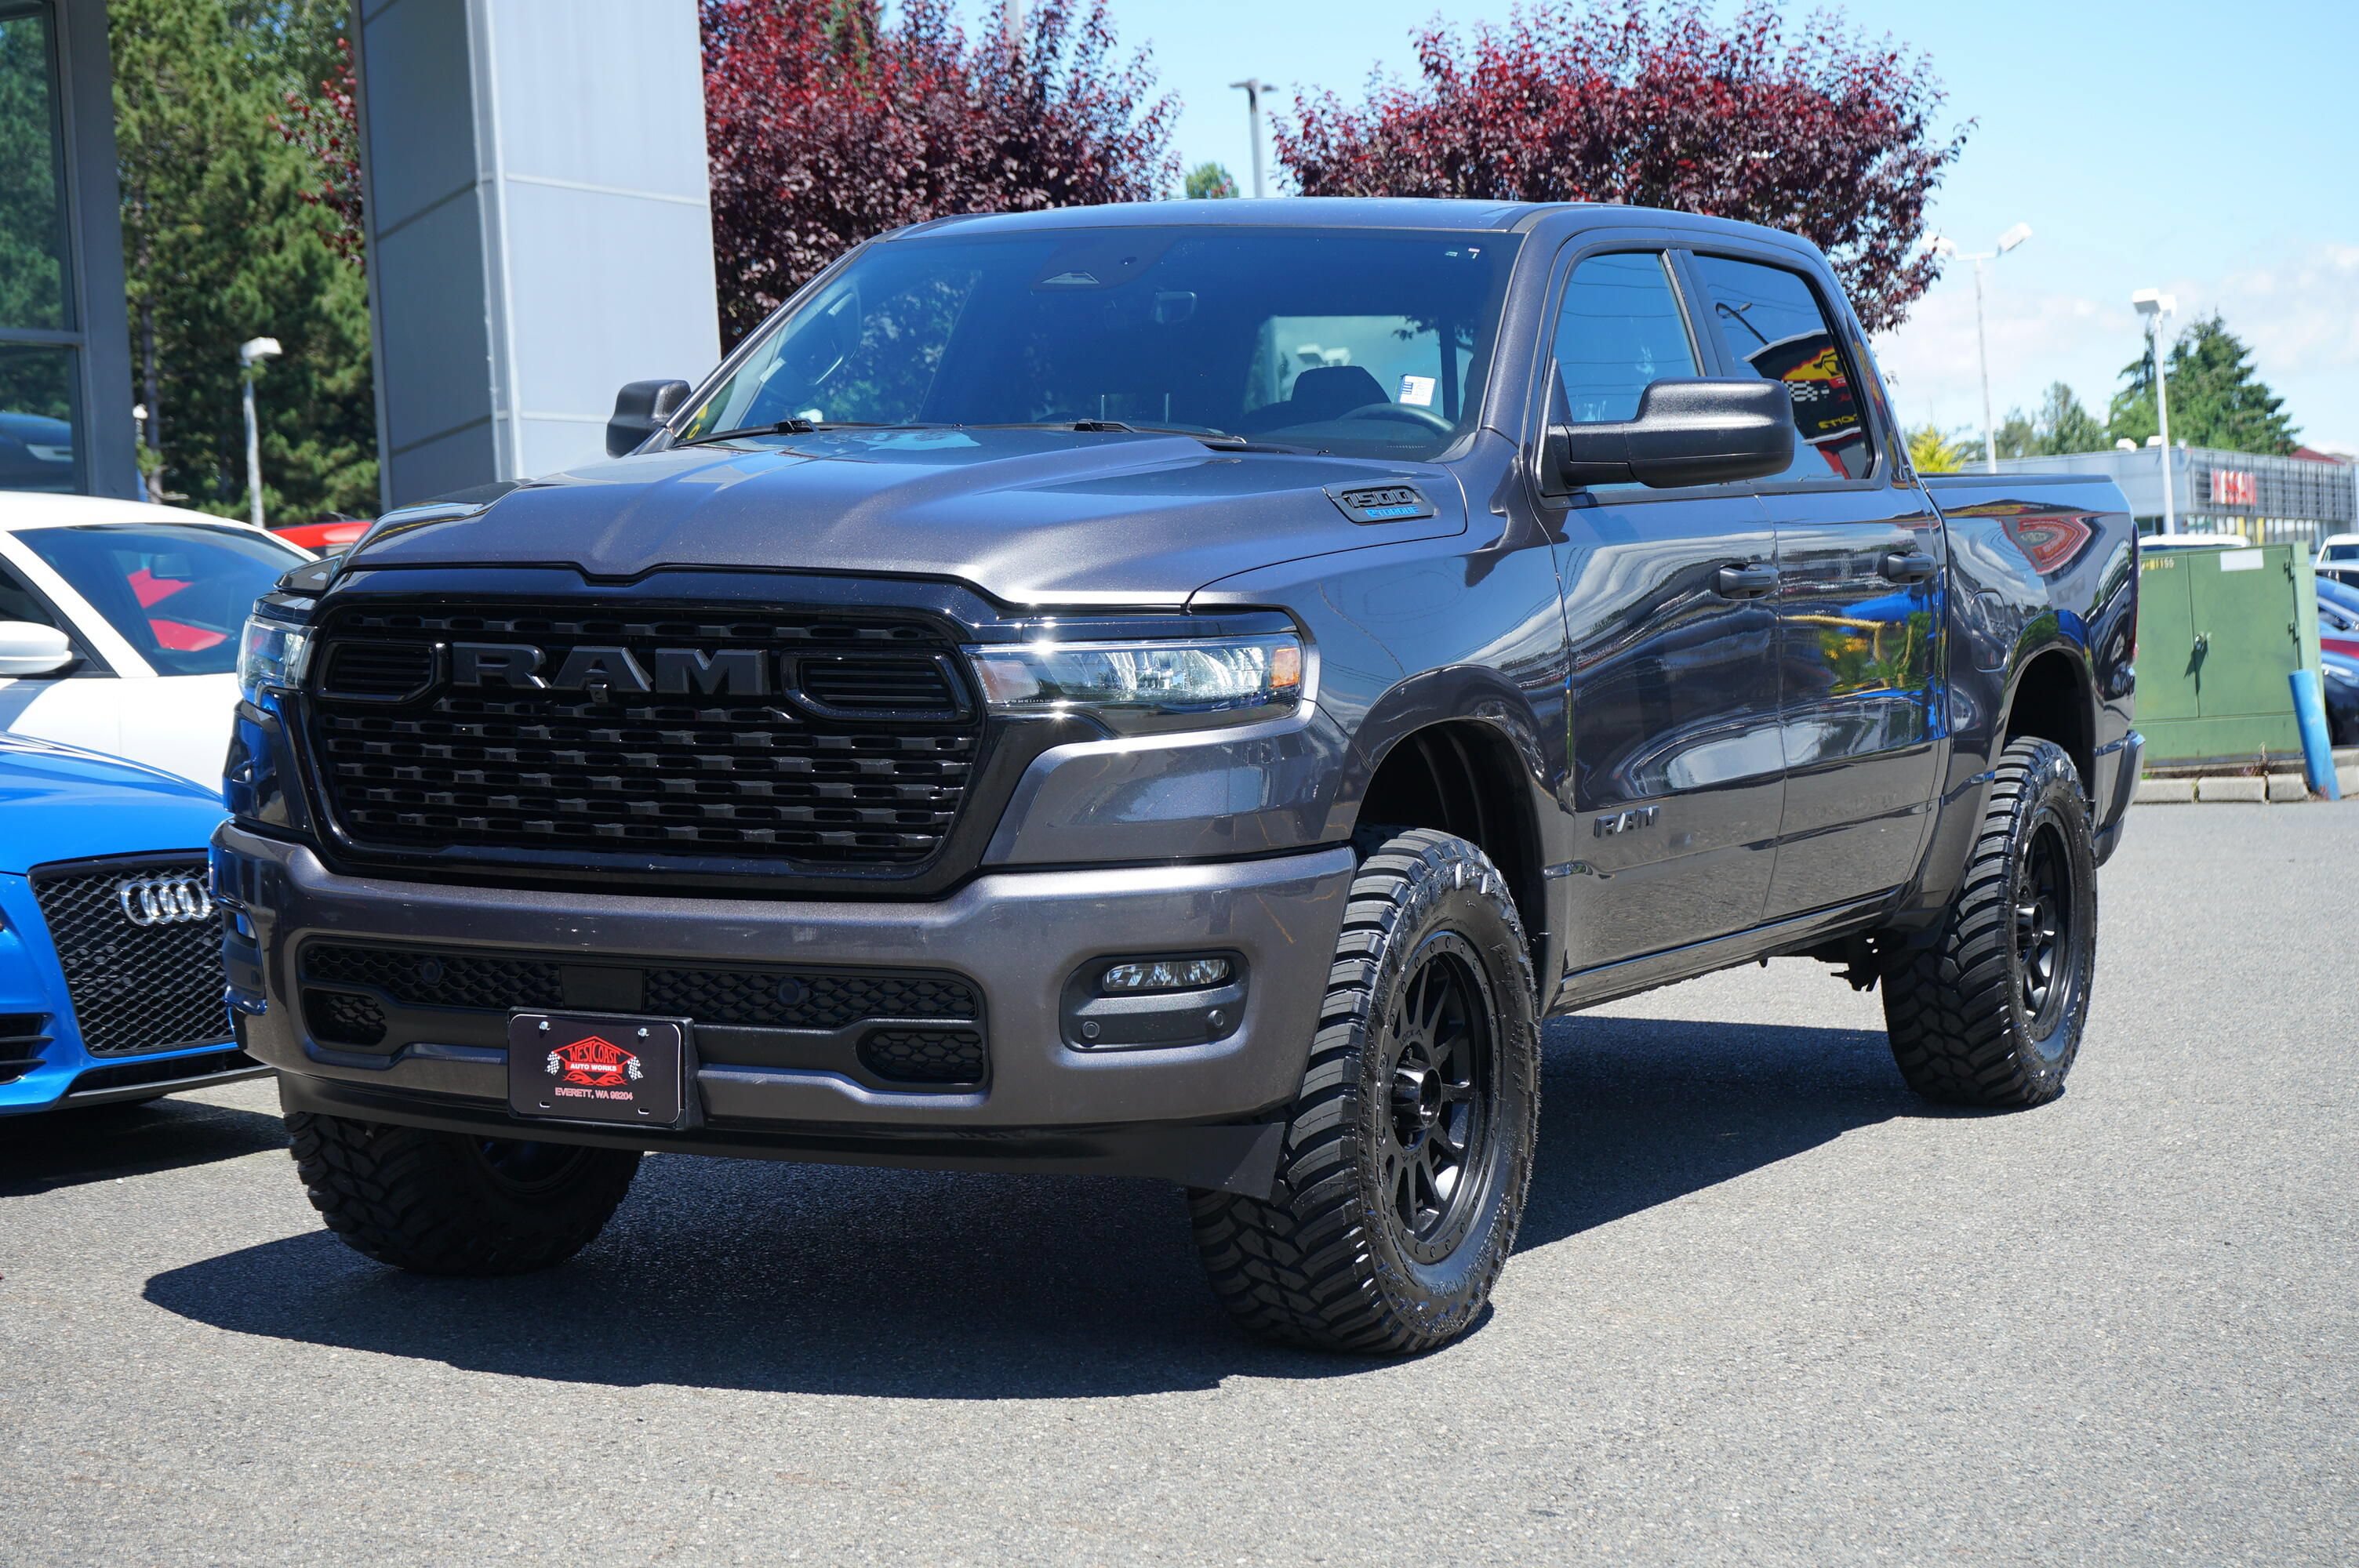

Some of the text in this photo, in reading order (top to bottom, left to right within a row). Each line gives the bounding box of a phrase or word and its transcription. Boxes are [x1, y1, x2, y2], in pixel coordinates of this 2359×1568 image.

[1343, 488, 1412, 508] 1500
[452, 641, 772, 695] RAM
[1593, 805, 1659, 837] RAM
[554, 1087, 594, 1099] EVERETT,
[595, 1090, 609, 1099] WA
